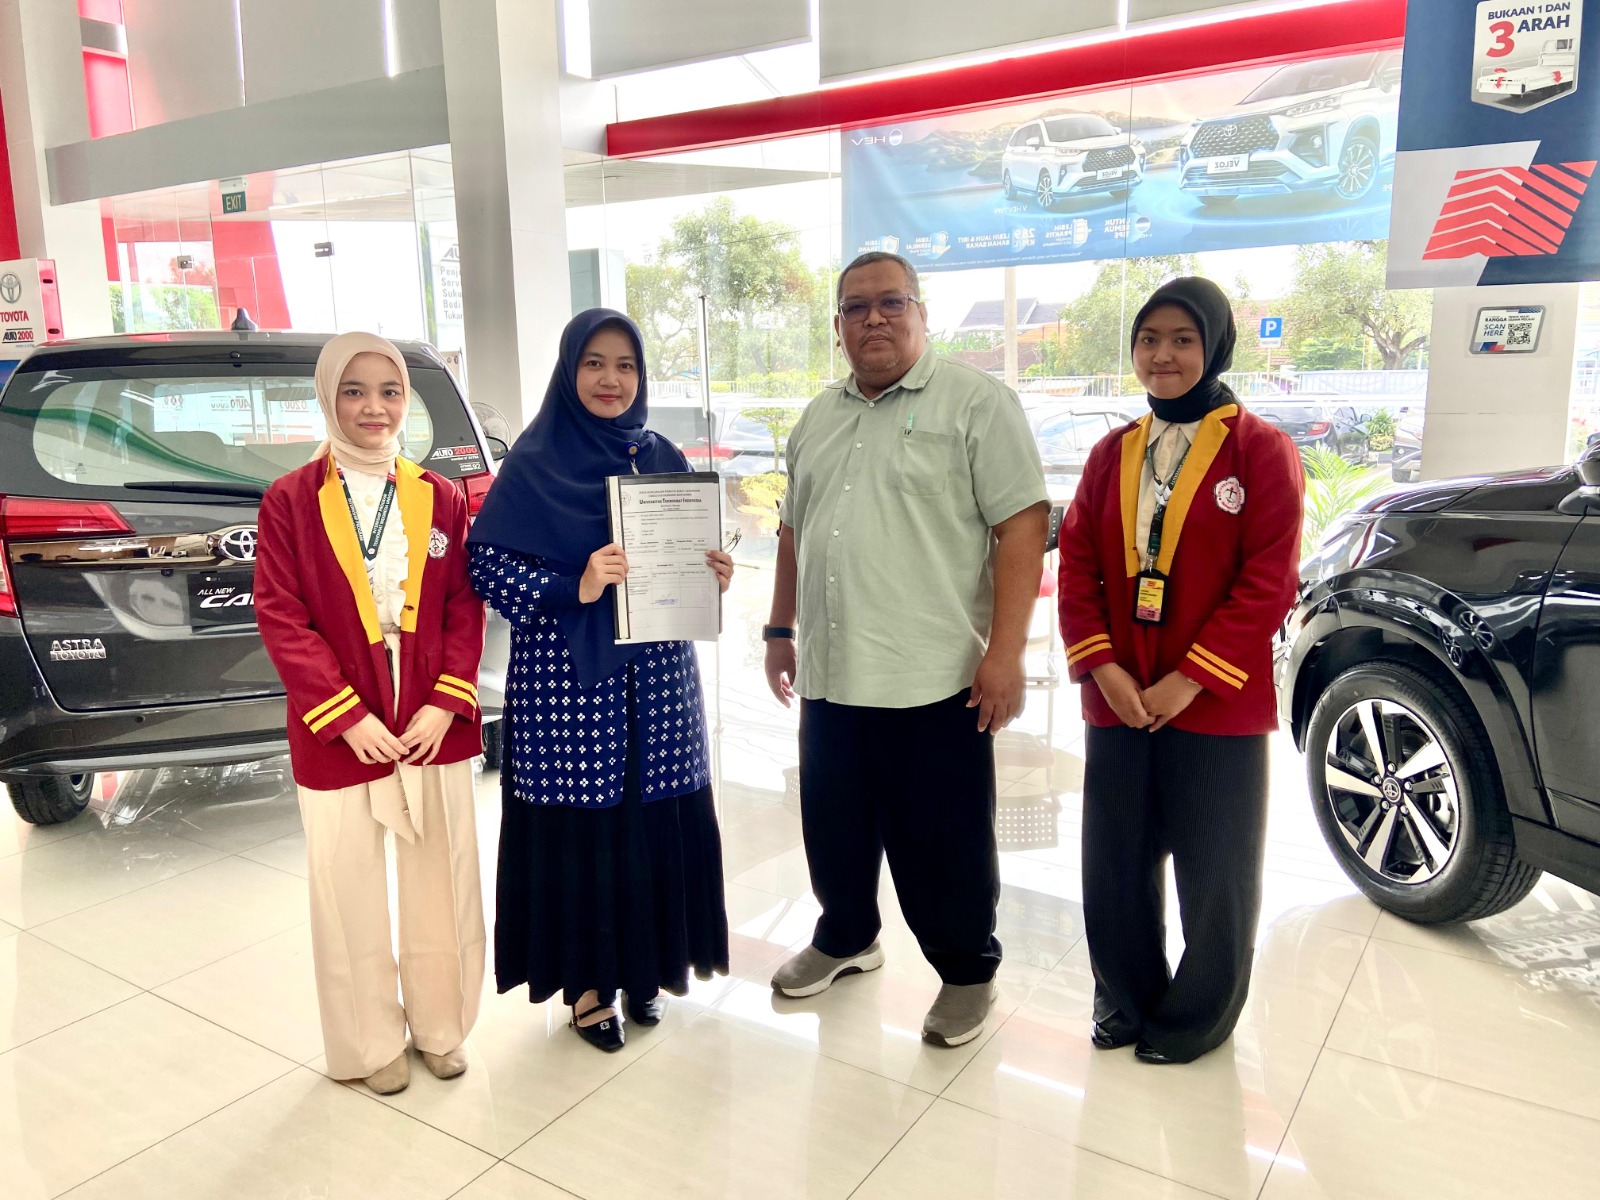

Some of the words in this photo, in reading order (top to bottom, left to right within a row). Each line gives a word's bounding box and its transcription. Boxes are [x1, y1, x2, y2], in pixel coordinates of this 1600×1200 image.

[1488, 6, 1534, 20] BUKAAN
[1538, 5, 1542, 13] 1
[1545, 2, 1570, 12] DAN
[1486, 21, 1514, 57] 3
[1517, 15, 1570, 33] ARAH
[226, 195, 241, 210] EXIT
[0, 311, 29, 322] TOYOTA
[1265, 320, 1277, 336] P
[3, 331, 17, 340] AUTO
[18, 331, 33, 340] 2000
[432, 449, 453, 457] AUTO
[454, 447, 477, 455] 2000
[200, 593, 254, 608] CA
[51, 638, 105, 651] ASTRA
[52, 650, 106, 660] TOYOTA
